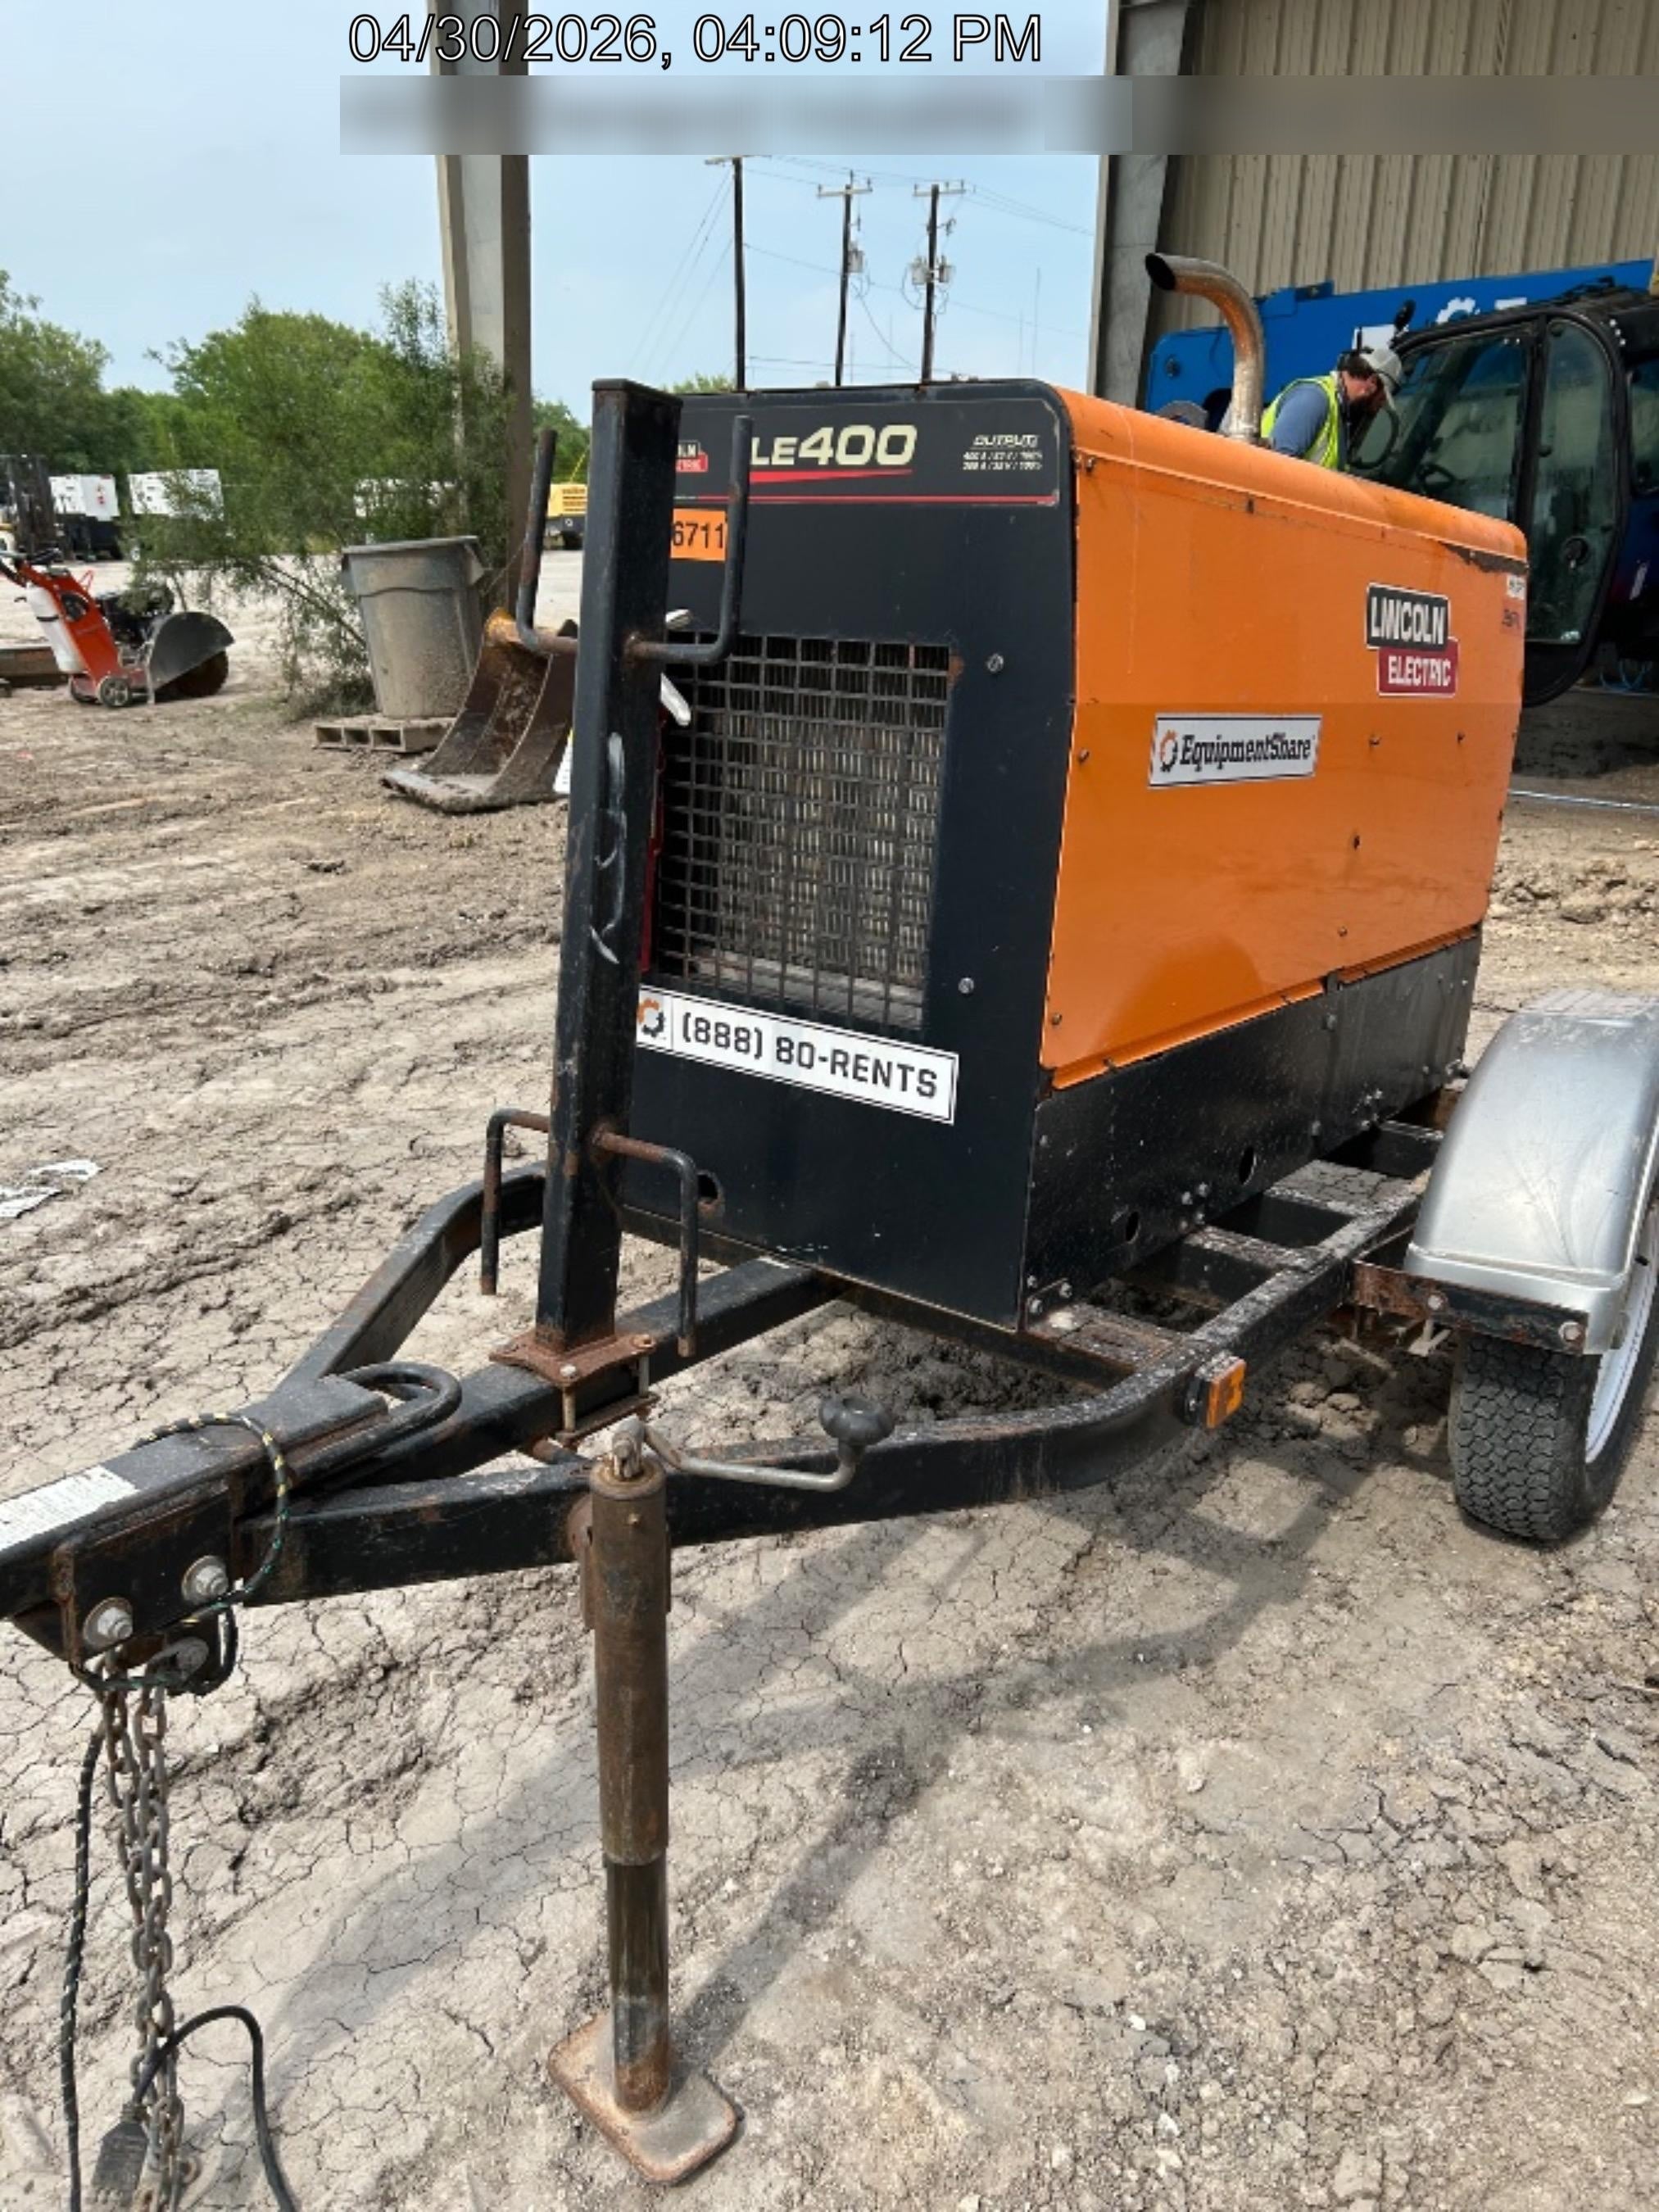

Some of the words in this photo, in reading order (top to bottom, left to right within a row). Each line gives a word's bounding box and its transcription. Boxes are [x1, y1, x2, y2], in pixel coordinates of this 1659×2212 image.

[1370, 595, 1447, 645] LINCOLN
[1387, 655, 1452, 687] ELECTRIC
[1179, 732, 1312, 773] EquipmentShare
[682, 1012, 764, 1059] (888)
[774, 1036, 940, 1099] 80-RENTS
